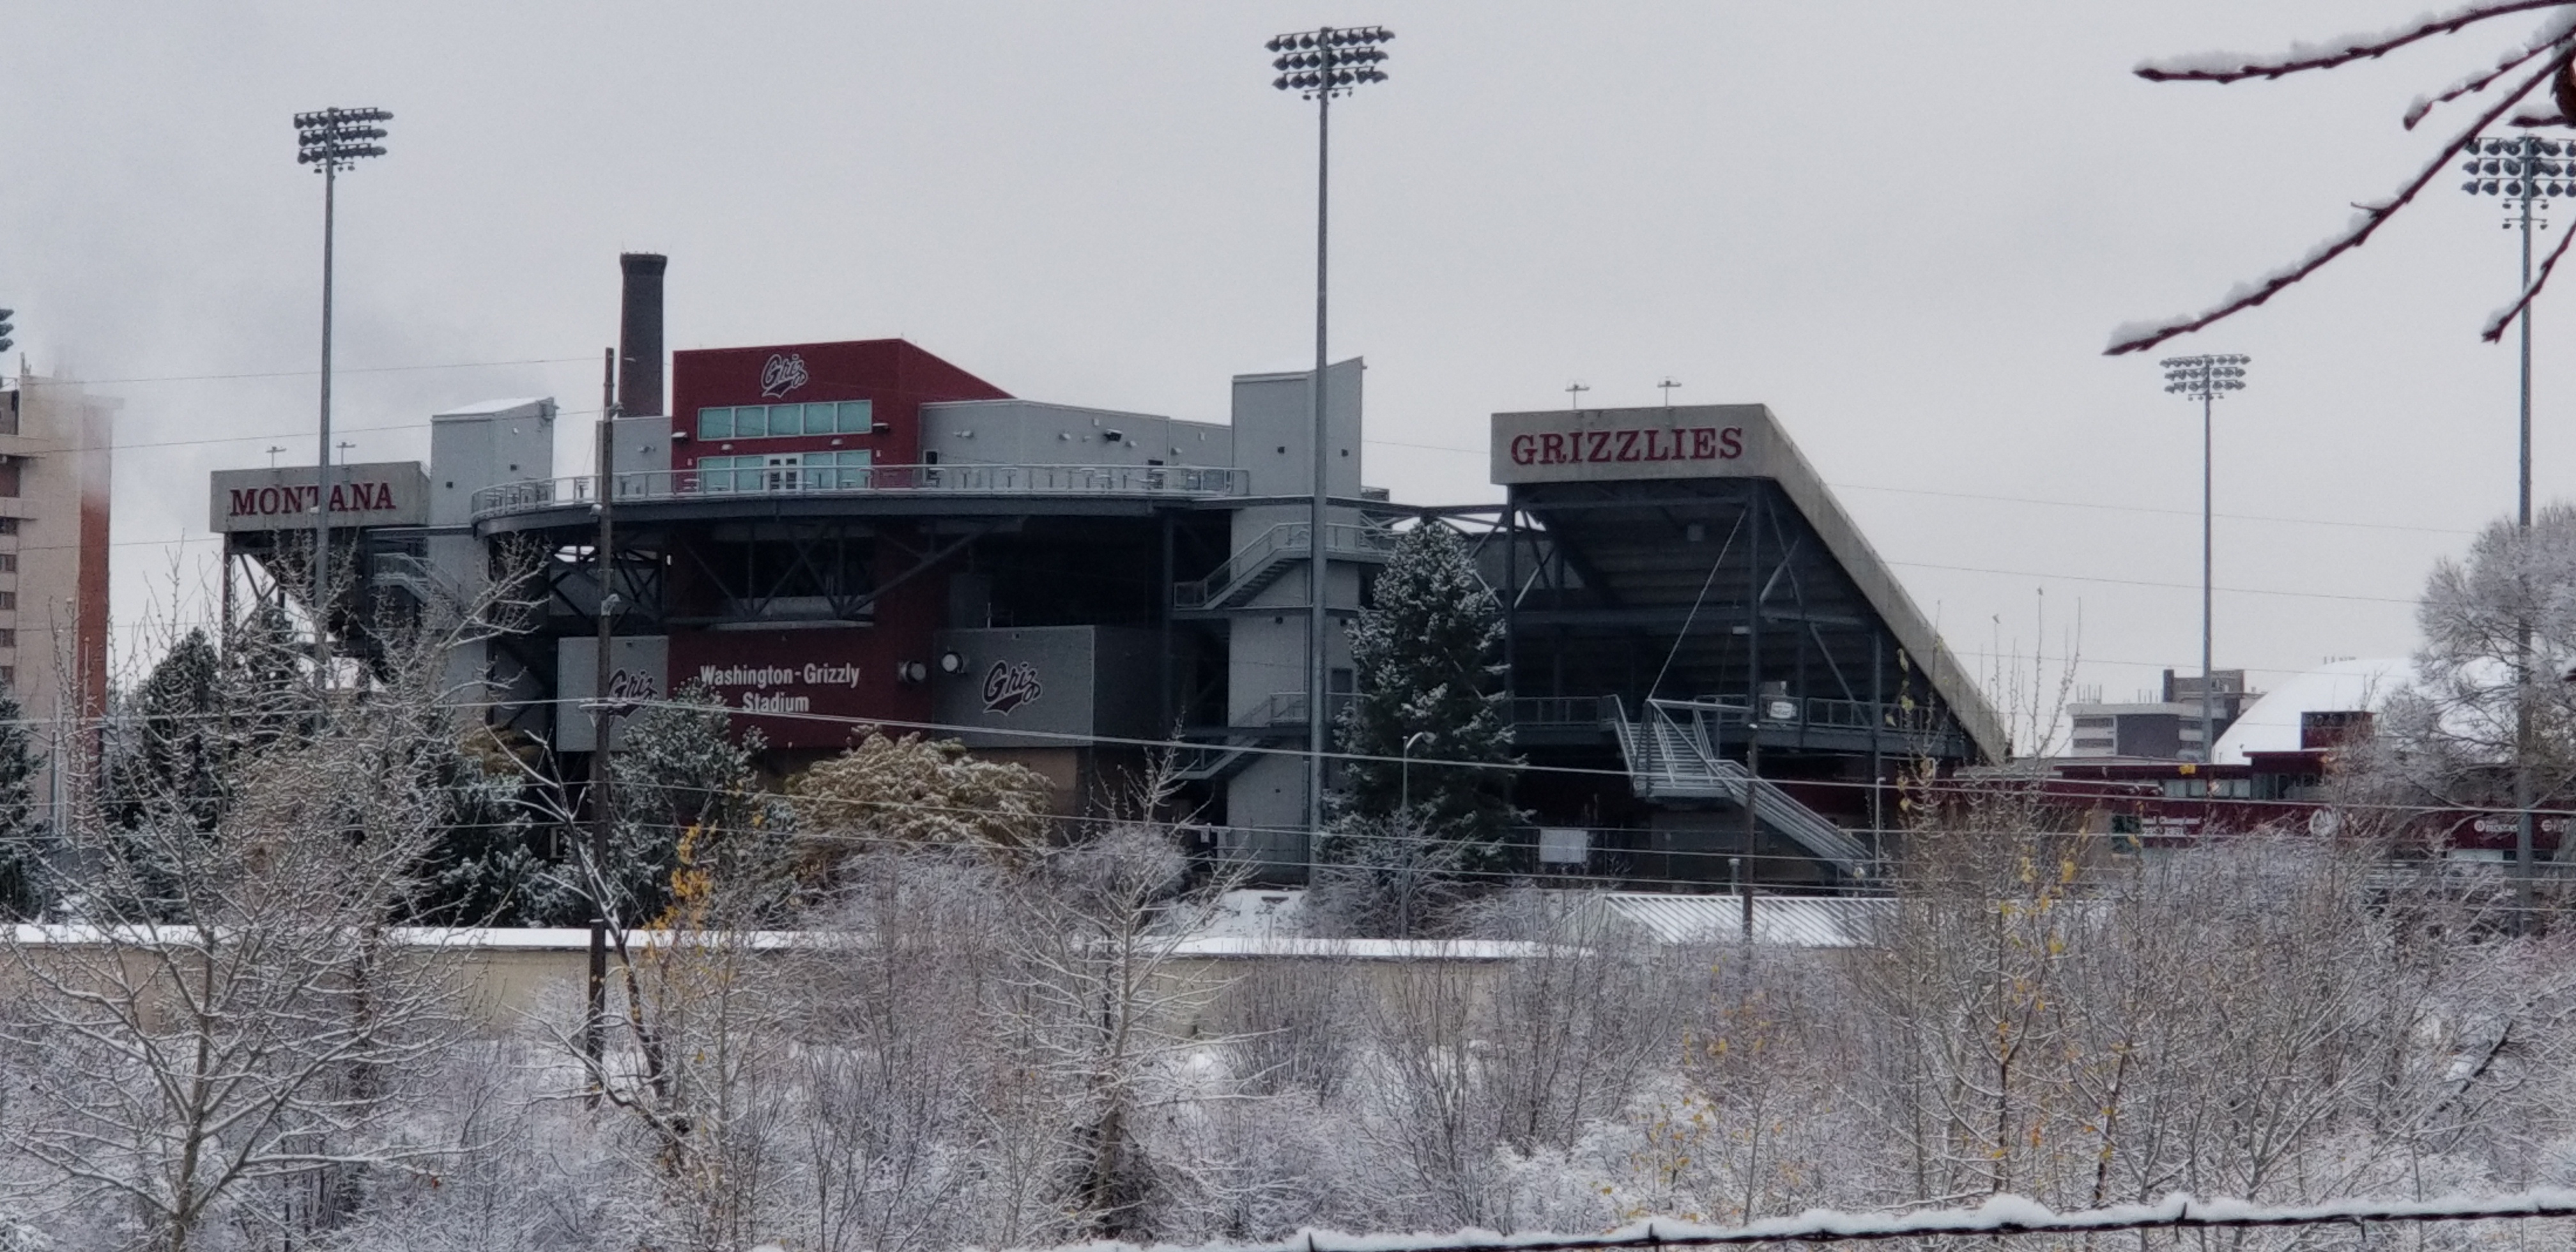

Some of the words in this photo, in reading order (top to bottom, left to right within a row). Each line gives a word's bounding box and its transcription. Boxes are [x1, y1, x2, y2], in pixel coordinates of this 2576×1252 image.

[761, 353, 808, 390] Griz
[1510, 427, 1743, 465] GRIZZLIES
[229, 482, 396, 516] MONTANA
[608, 668, 659, 710] Griz
[700, 662, 861, 689] Washington-Grizzly
[982, 660, 1043, 705] Griz
[742, 691, 810, 713] Stadium
